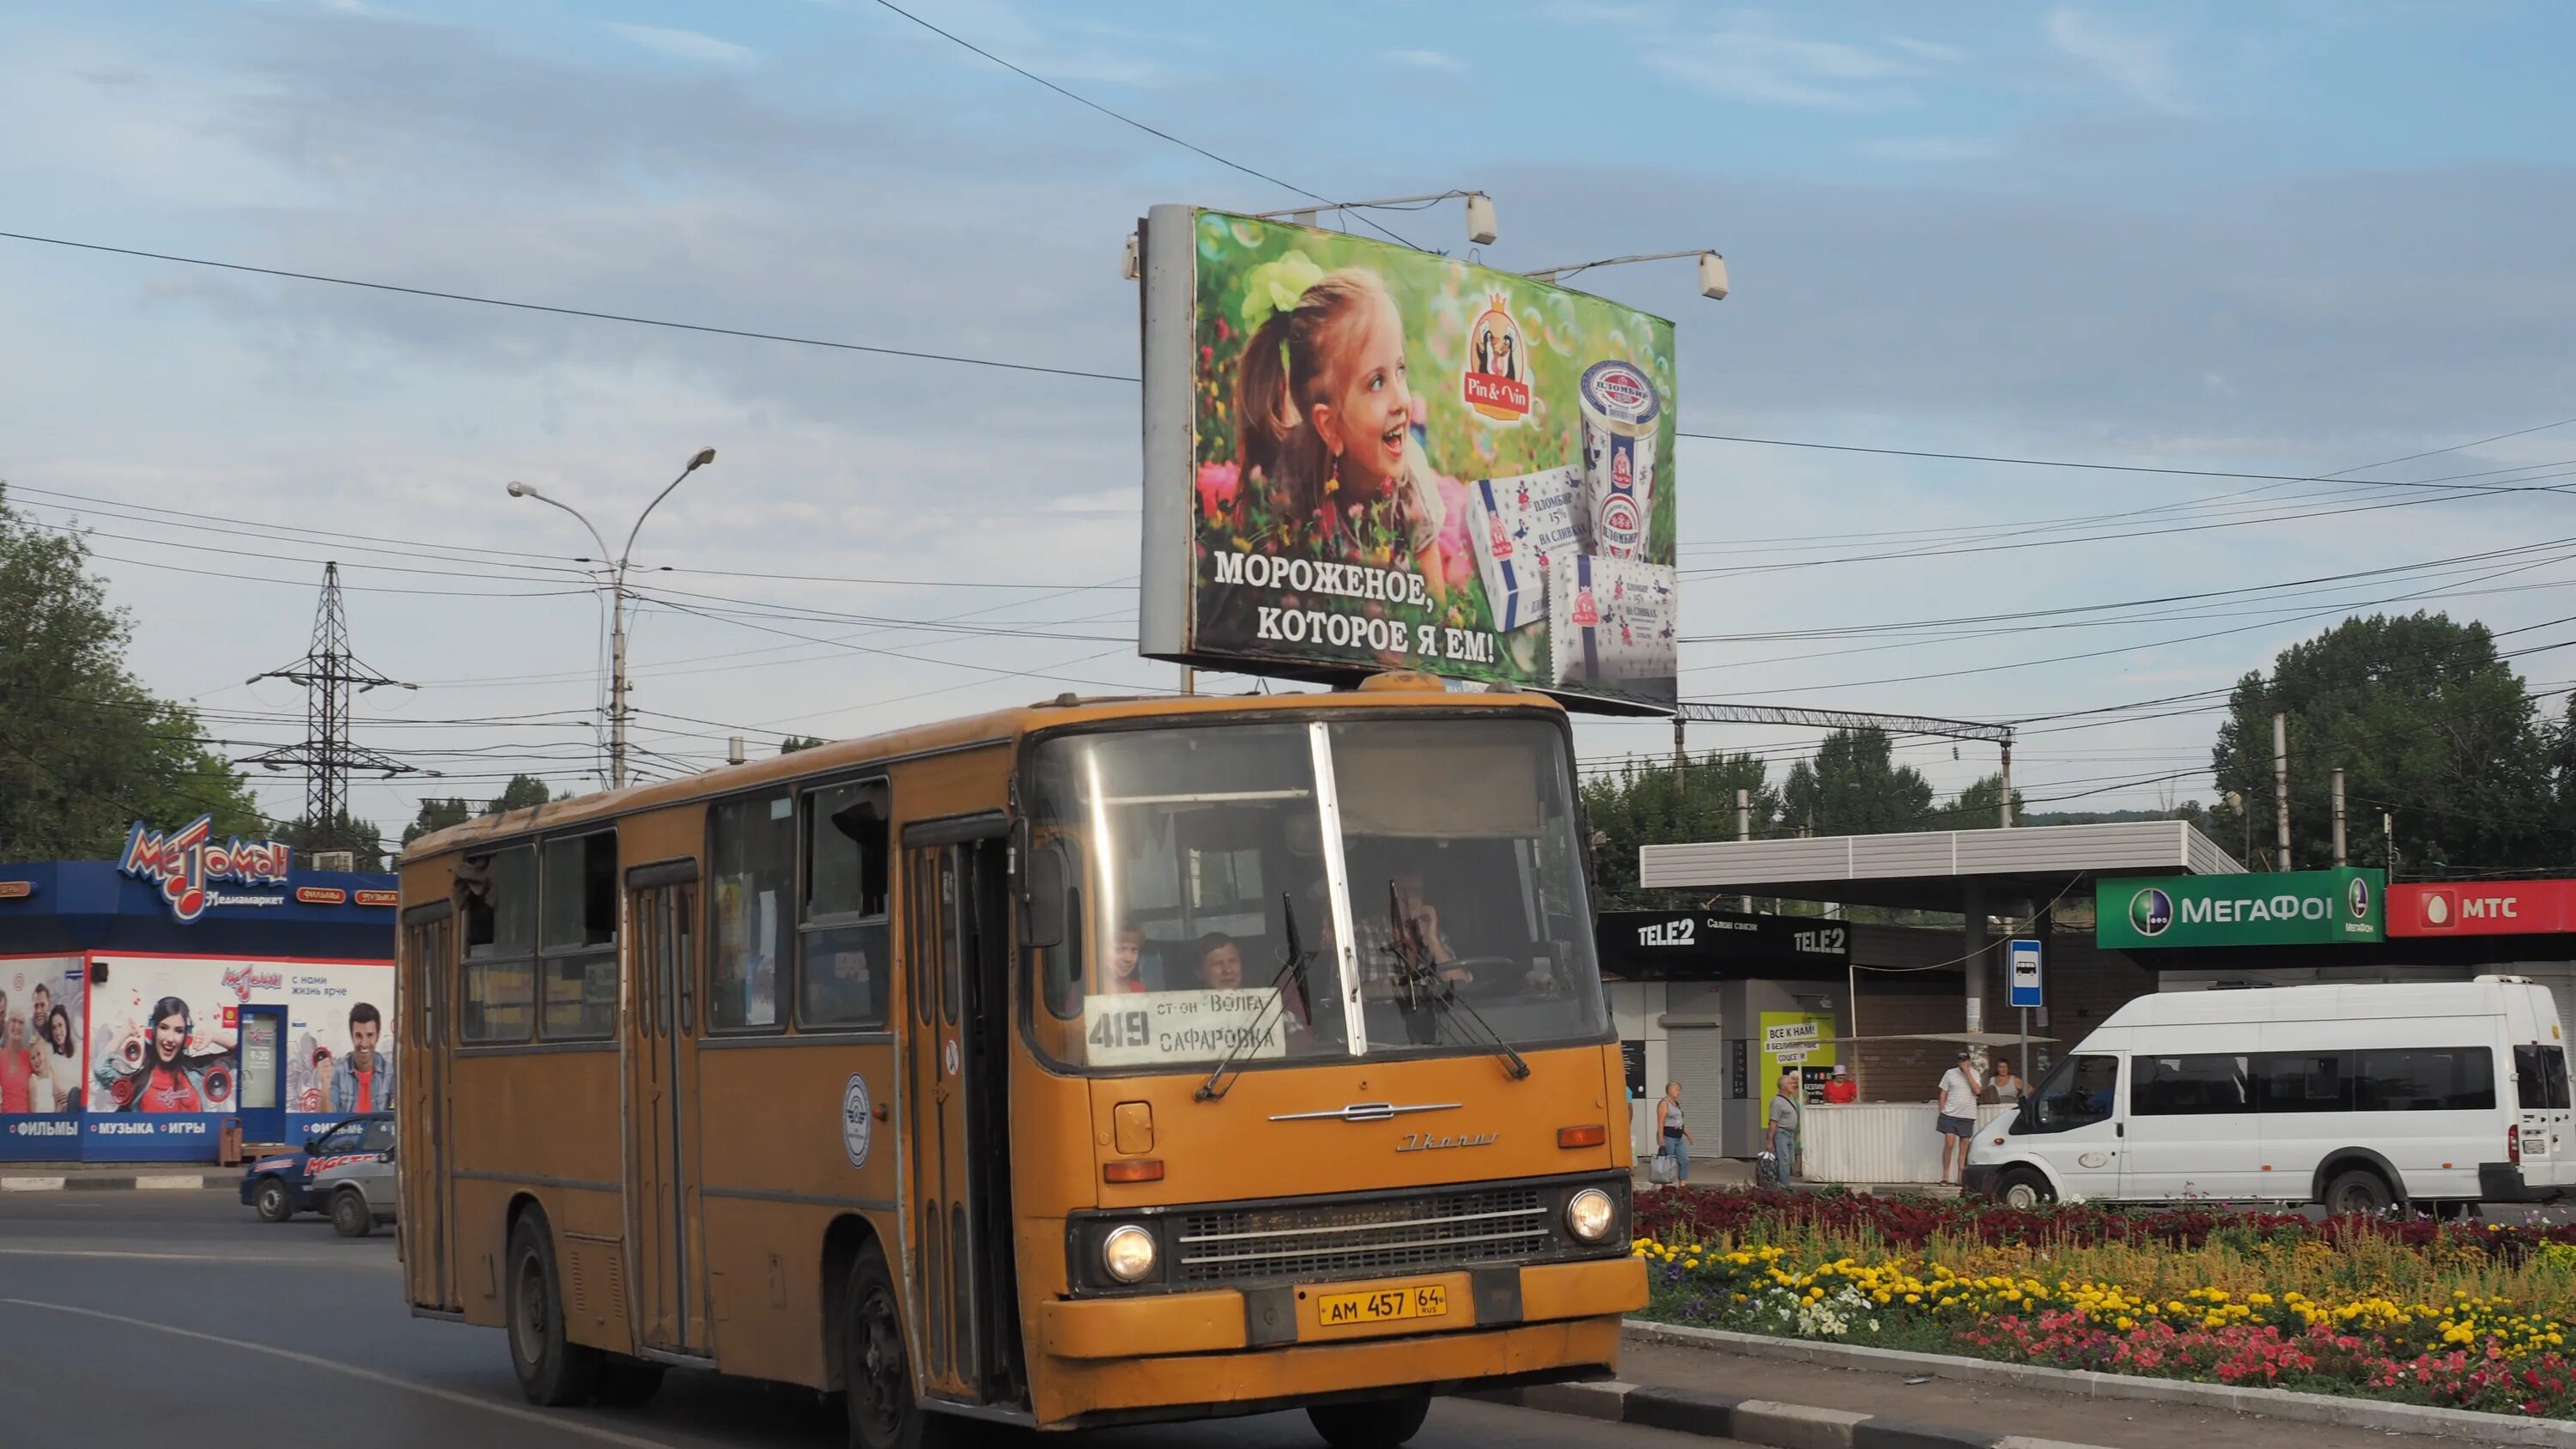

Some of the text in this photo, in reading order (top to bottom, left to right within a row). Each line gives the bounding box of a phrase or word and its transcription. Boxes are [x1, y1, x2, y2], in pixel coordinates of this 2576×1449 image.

[1467, 378, 1526, 406] Pin & Vin
[1596, 380, 1649, 401] ПЛОМБИР
[1534, 492, 1572, 512] ПЛОМБИР
[1548, 508, 1567, 525] 15%
[1538, 532, 1552, 546] НА
[1602, 527, 1638, 544] ПЛОМБИР
[1213, 550, 1434, 613] МОРОЖЕНОЕ,
[1257, 606, 1495, 664] КОТОРОЕ Я ЕМ!
[205, 891, 285, 907] Медиамаркет
[303, 889, 341, 900] ФИЛЬМЫ
[2462, 897, 2518, 919] МТС
[1637, 918, 1695, 946] TELE2
[1707, 918, 1758, 931] Салон связи
[1794, 927, 1845, 955] TELE2
[324, 988, 348, 997] ярче
[1088, 1010, 1151, 1049] 419
[1769, 1025, 1816, 1040] ВСЕ К НАМ!
[1159, 1027, 1276, 1053] САФАРОВКА
[17, 1121, 78, 1136] ФИЛЬМЫ
[98, 1122, 155, 1135] МУЗЫКА
[168, 1122, 206, 1134] ИГРЫ
[1396, 1132, 1498, 1152] Ikarus
[1331, 1288, 1439, 1321] АМ 457 64
